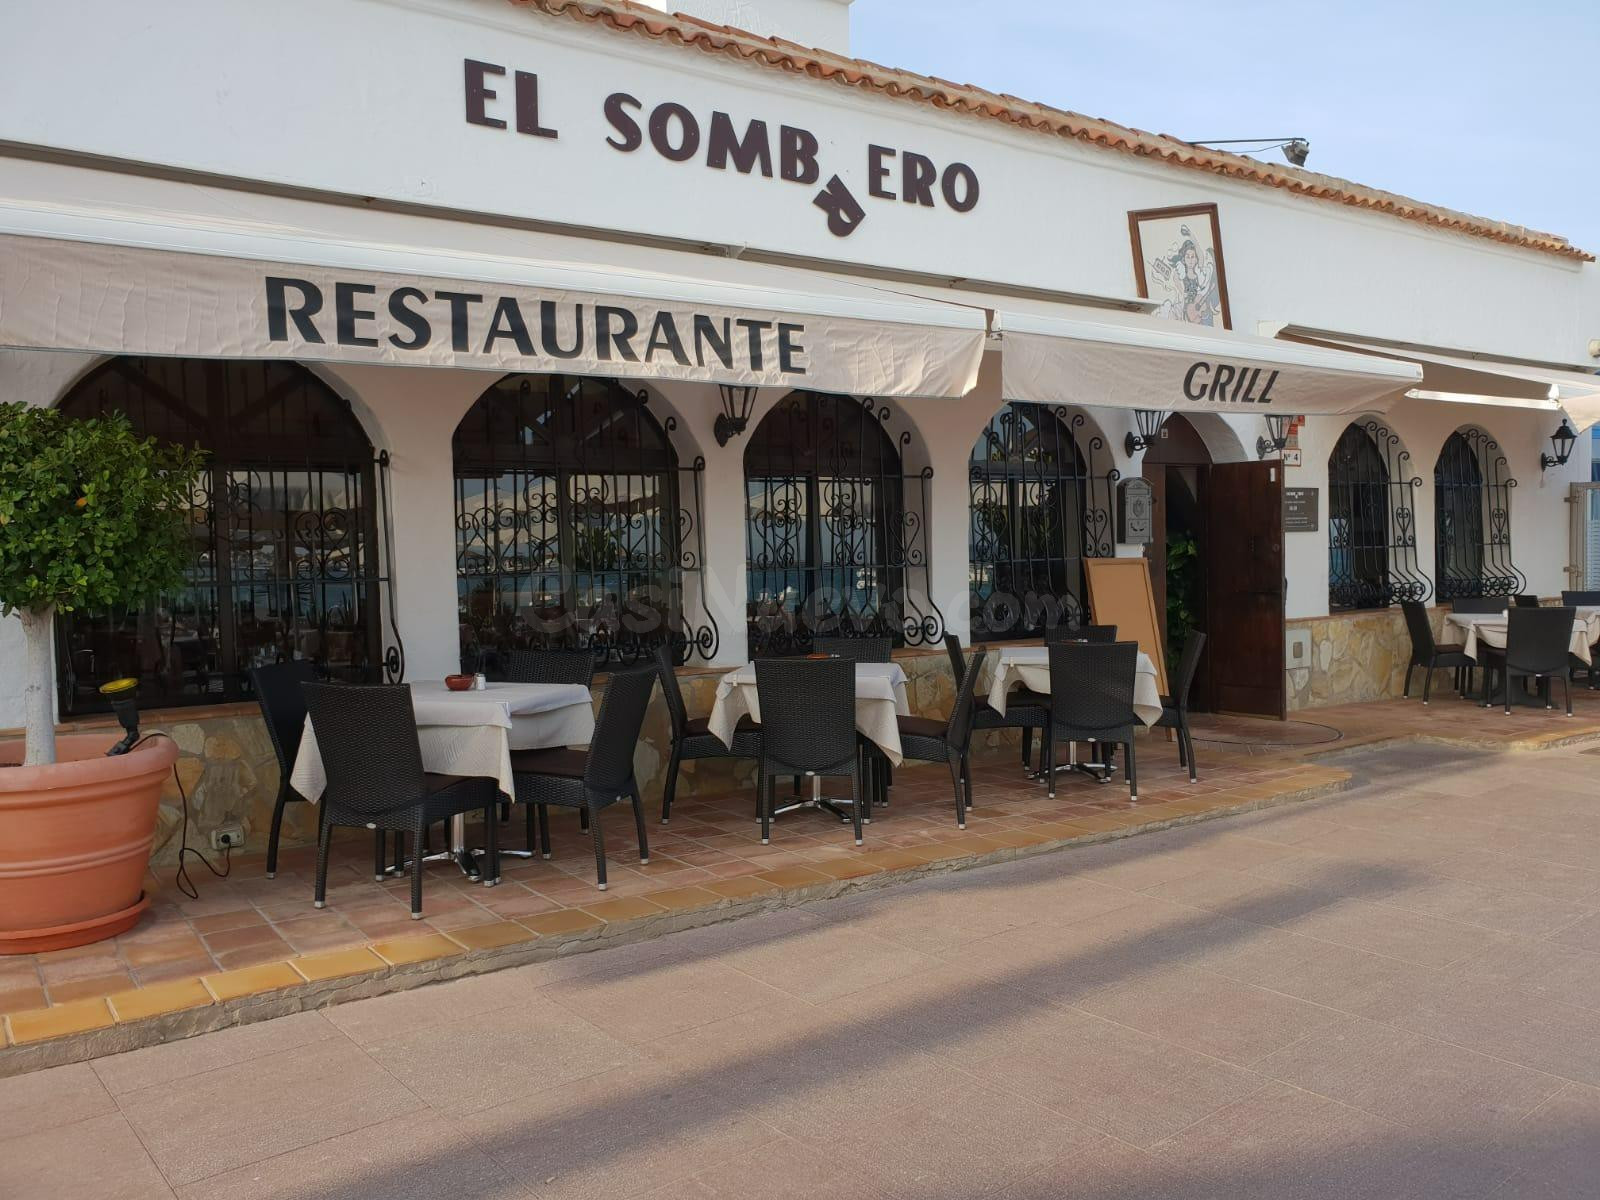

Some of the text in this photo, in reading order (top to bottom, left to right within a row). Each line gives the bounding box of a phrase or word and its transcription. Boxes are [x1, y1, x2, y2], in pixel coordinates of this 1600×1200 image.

[464, 58, 980, 237] EL SOMBRERO
[264, 276, 807, 376] RESTAURANTE
[1183, 361, 1280, 404] GRILL
